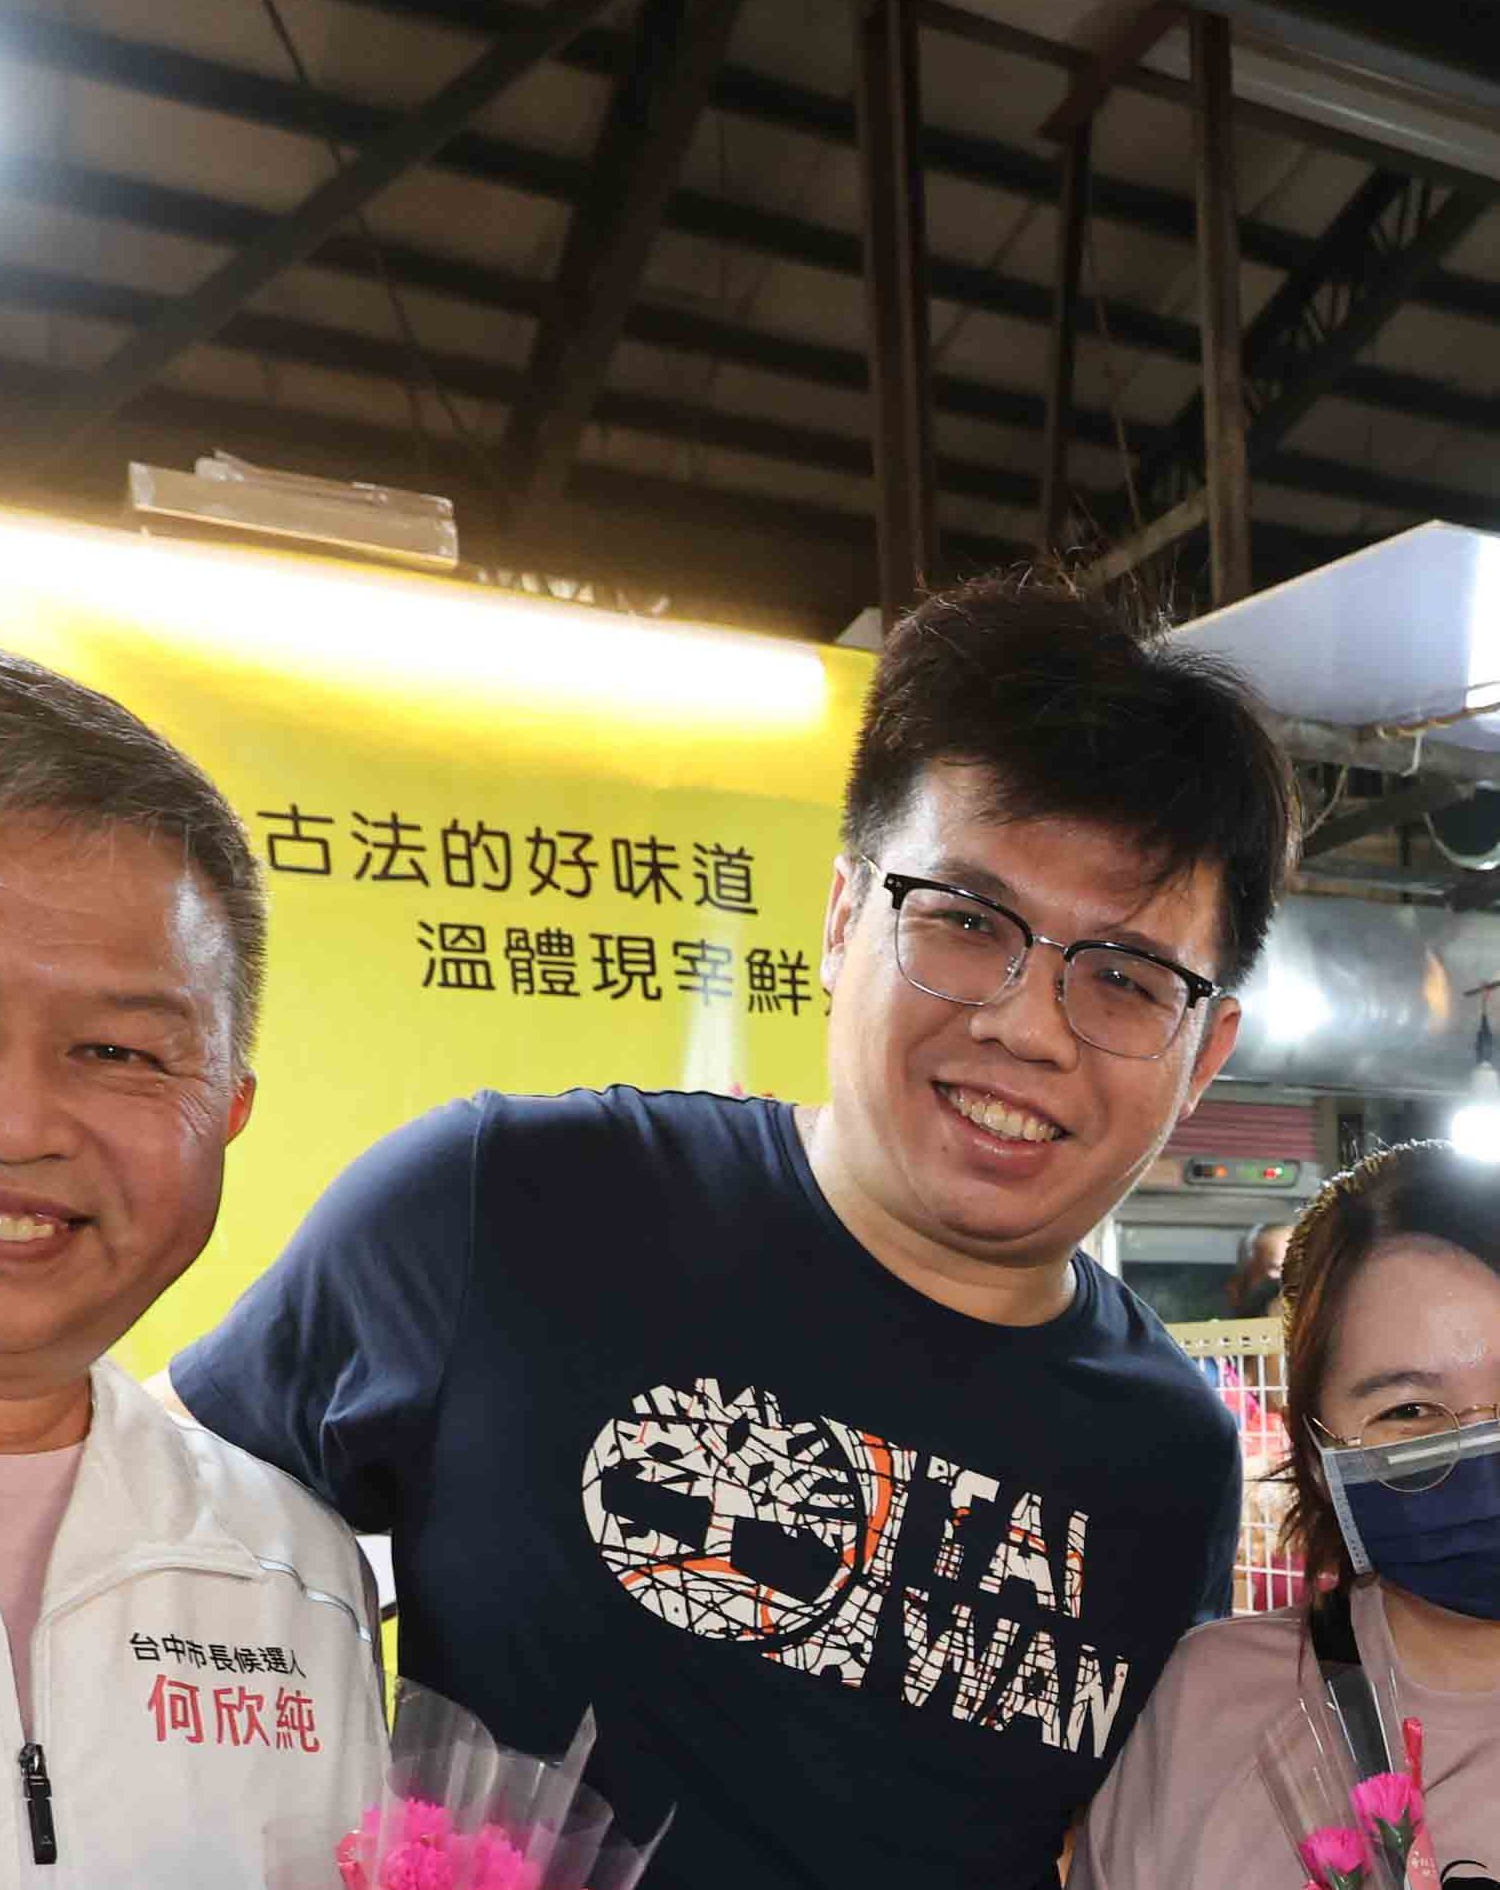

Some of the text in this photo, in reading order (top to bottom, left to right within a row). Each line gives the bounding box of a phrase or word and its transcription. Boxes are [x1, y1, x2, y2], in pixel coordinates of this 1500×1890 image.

[256, 803, 760, 917] 古法的好味道
[416, 919, 831, 1018] 溫體現宰鮮
[129, 1632, 307, 1678] 台中市長候選人
[148, 1673, 321, 1752] 何欣純
